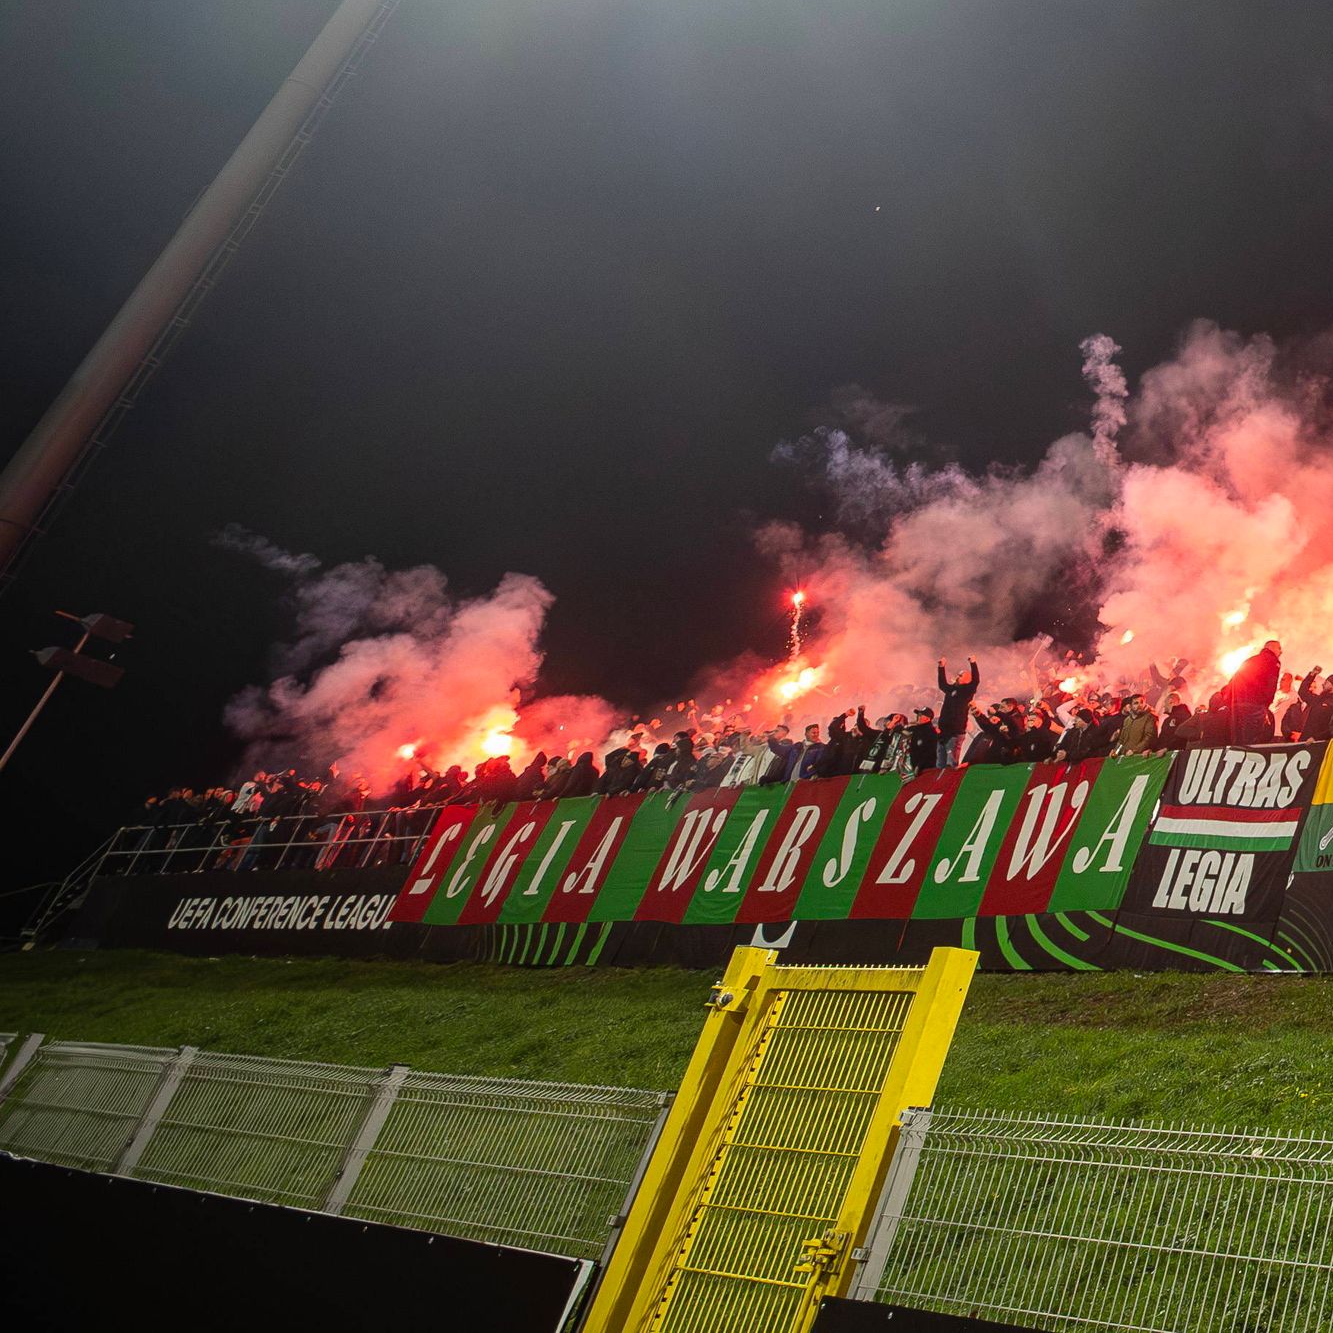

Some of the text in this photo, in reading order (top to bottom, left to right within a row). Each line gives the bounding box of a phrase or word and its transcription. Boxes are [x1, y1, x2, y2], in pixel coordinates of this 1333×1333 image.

[1178, 749, 1312, 808] ULTRAS
[408, 774, 1150, 908] LEGIA WARSZAWA
[167, 894, 398, 930] UEFA CONFERENCE LEAGU
[1152, 848, 1255, 914] LEGIA
